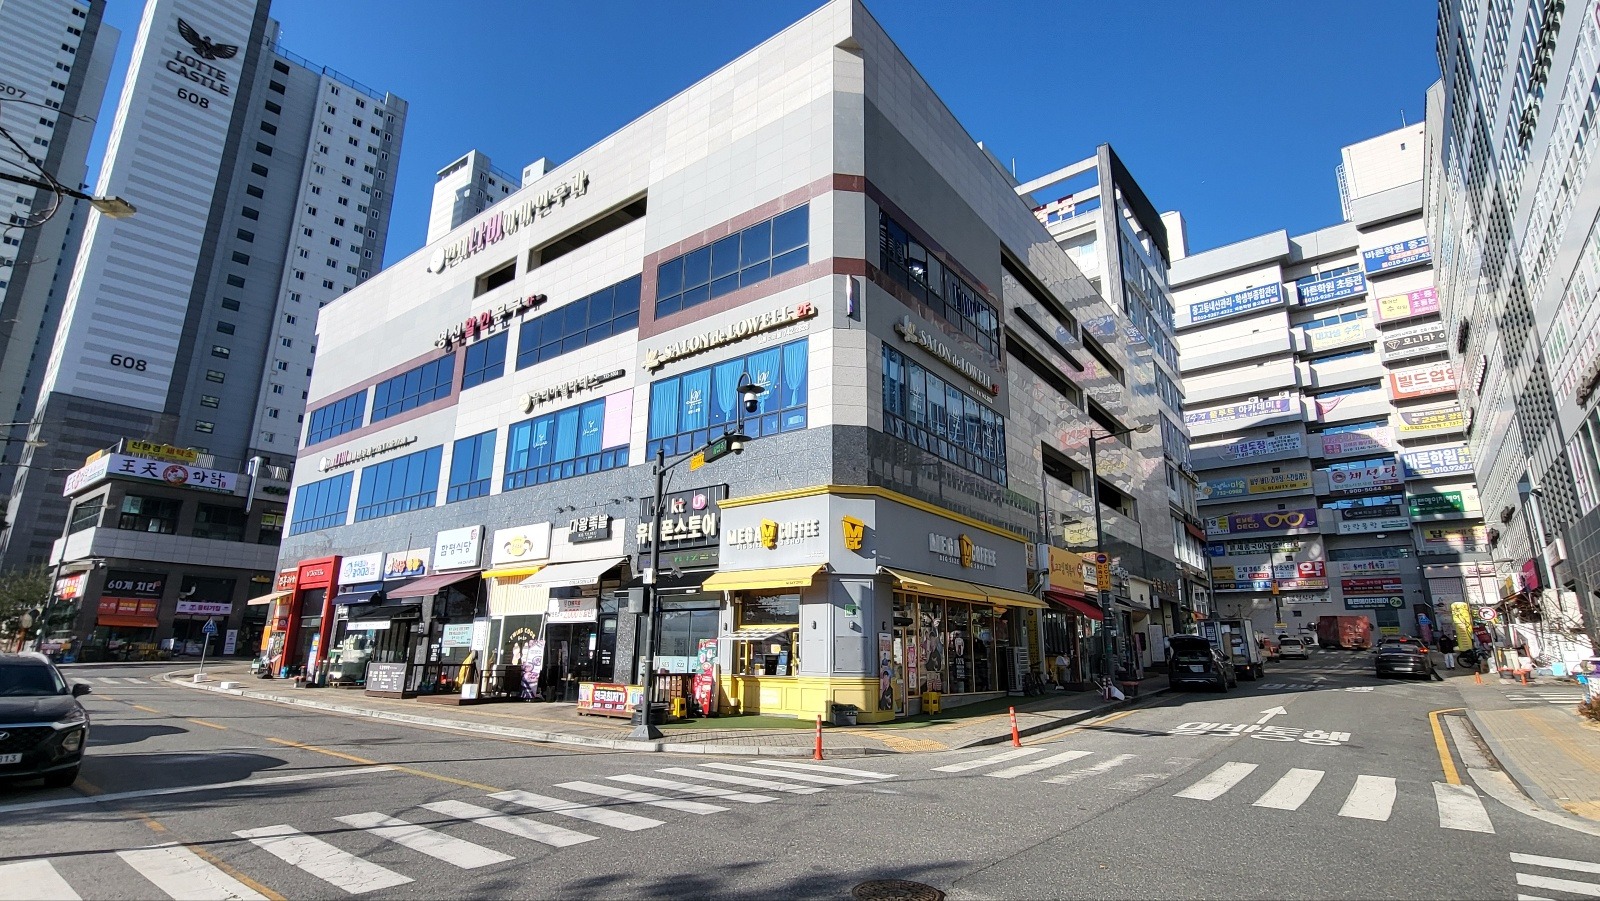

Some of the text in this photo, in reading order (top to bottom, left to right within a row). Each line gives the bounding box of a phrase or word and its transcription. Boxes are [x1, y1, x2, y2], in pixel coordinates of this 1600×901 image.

[176, 50, 227, 83] LOTTE
[166, 59, 230, 97] CASTLE
[177, 87, 210, 109] 608
[664, 331, 711, 359] SALON
[711, 330, 727, 346] de
[727, 304, 794, 341] LOWELL
[1403, 334, 1435, 347] 모니카
[110, 353, 147, 371] 608
[920, 329, 952, 362] SALON
[961, 356, 991, 388] LOWELL
[1238, 399, 1275, 413] 아카데미
[1403, 448, 1457, 470] 바른학원
[118, 459, 159, 478] 王天
[193, 471, 226, 488] 파닭
[1348, 465, 1397, 480] 채선당
[671, 498, 685, 513] kt
[727, 525, 761, 546] MEGA
[780, 519, 819, 540] COFFEE
[929, 533, 960, 557] MEGA
[972, 544, 997, 567] COFFEE
[1299, 561, 1325, 578] 약
[107, 579, 157, 592] 60계 치킨
[1167, 721, 1351, 747] 일방통행
